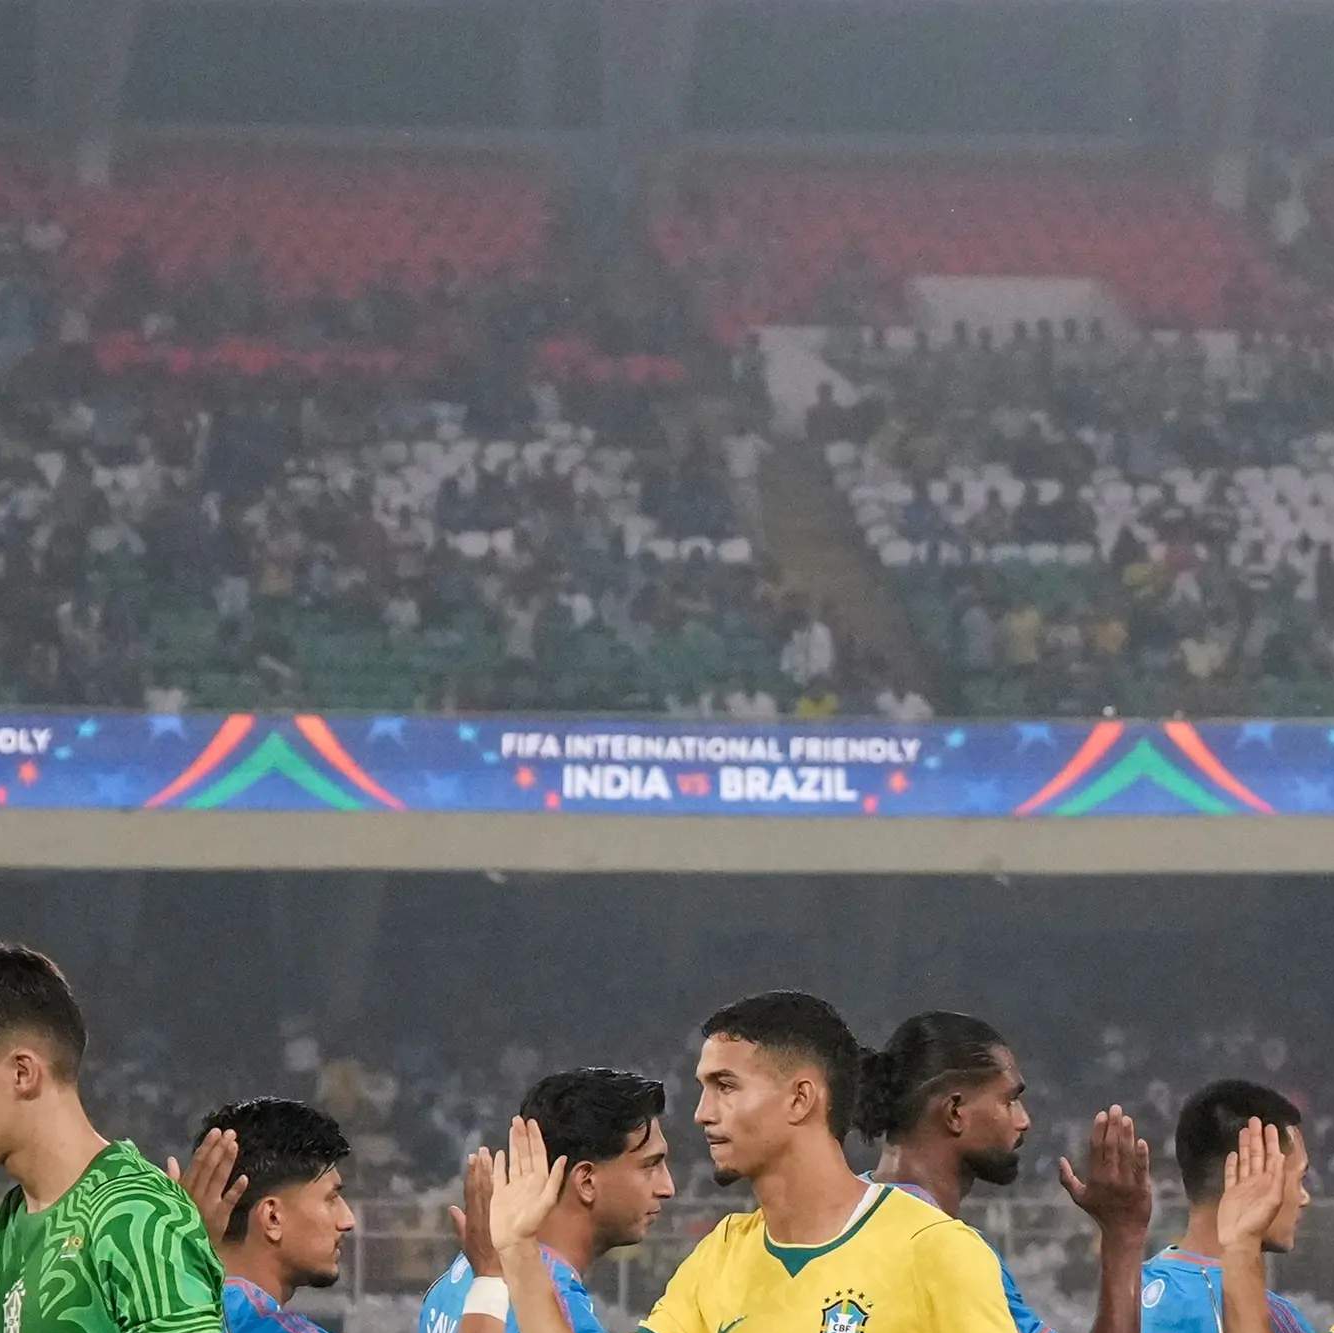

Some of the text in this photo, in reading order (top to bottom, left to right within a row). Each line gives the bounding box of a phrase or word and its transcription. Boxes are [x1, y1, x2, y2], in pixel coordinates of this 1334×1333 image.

[502, 733, 922, 764] FIFA INTERNATIONAL FRIENDLY
[563, 766, 672, 801] INDIA
[720, 767, 859, 803] BRAZIL
[832, 1323, 852, 1333] CBF
